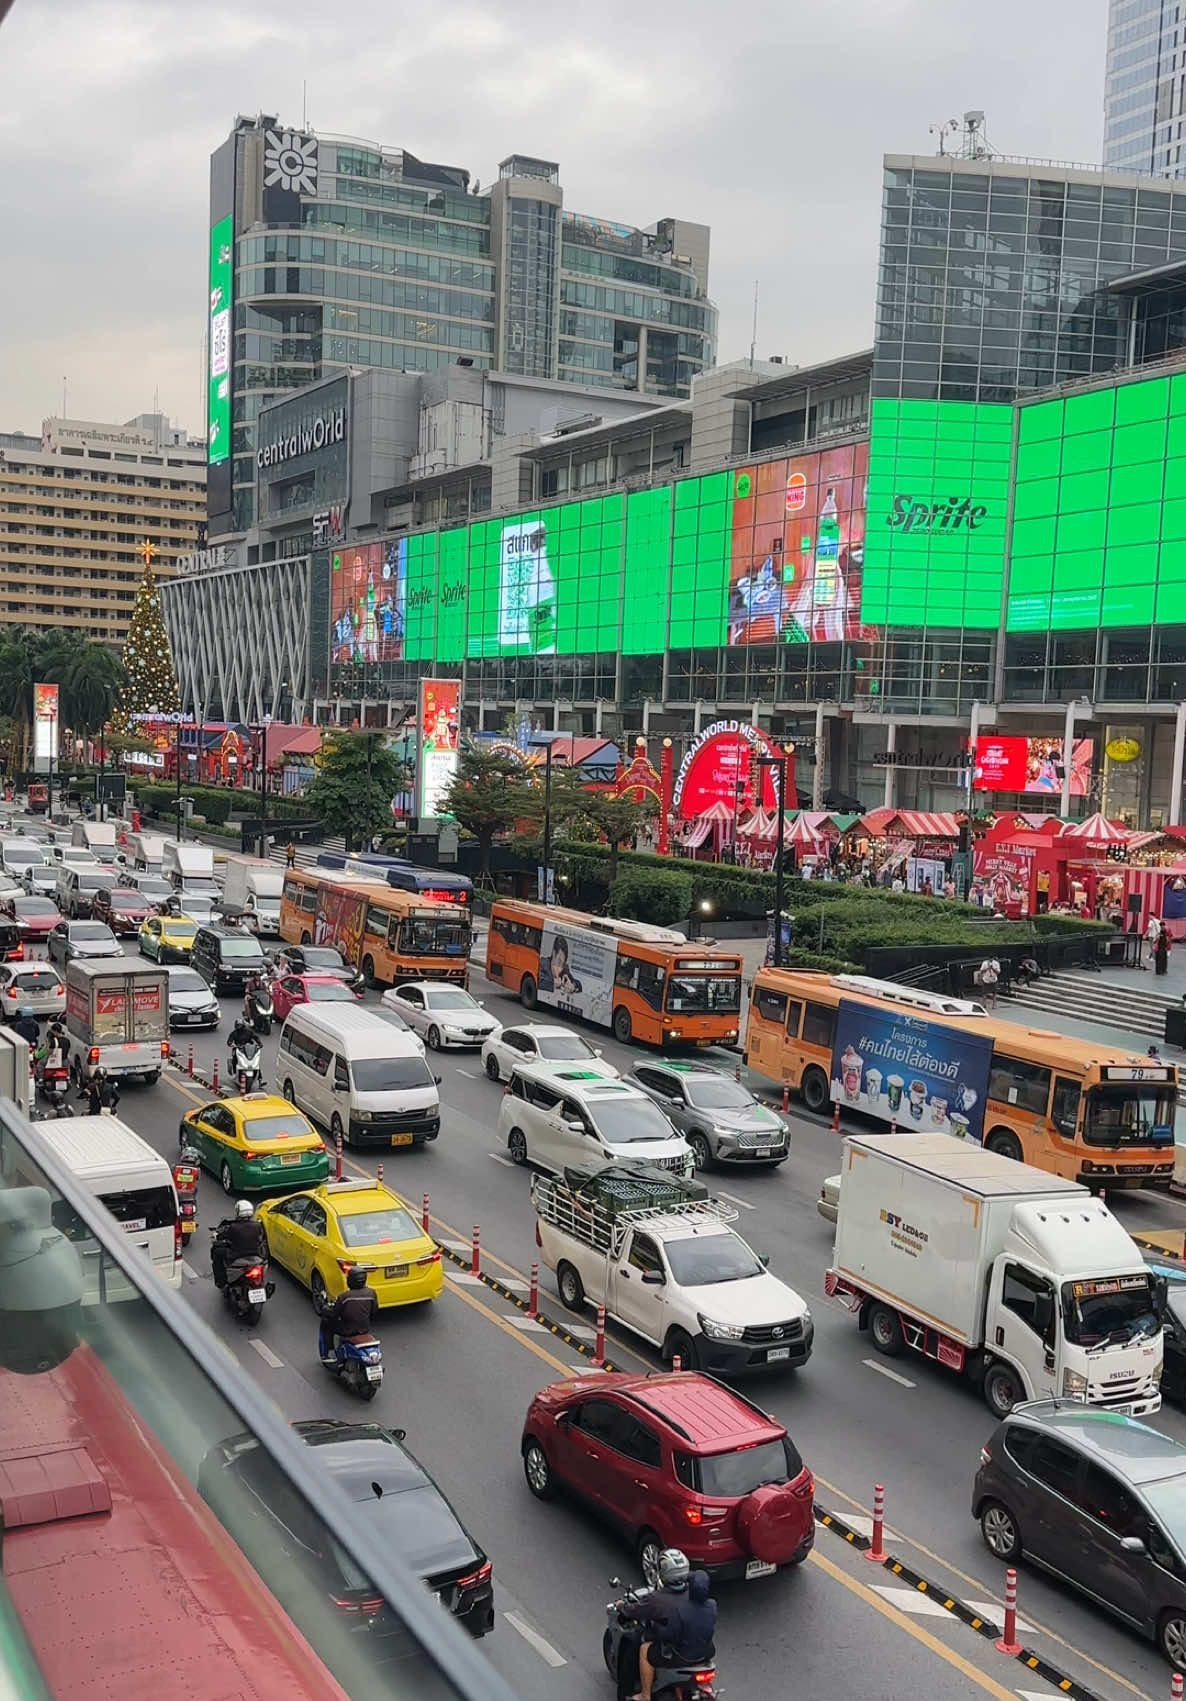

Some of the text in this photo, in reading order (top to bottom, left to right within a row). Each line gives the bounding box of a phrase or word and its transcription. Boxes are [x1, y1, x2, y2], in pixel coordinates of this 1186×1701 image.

[257, 408, 345, 468] centralwOrld
[885, 495, 988, 534] Sprite
[408, 585, 433, 611] Sprite
[441, 579, 466, 608] Sprite
[890, 1027, 928, 1048] โครงการ
[858, 1036, 961, 1079] #คนไทยไส้ต้องดี
[1131, 1069, 1144, 1080] 79
[1109, 1370, 1136, 1380] ISUZU
